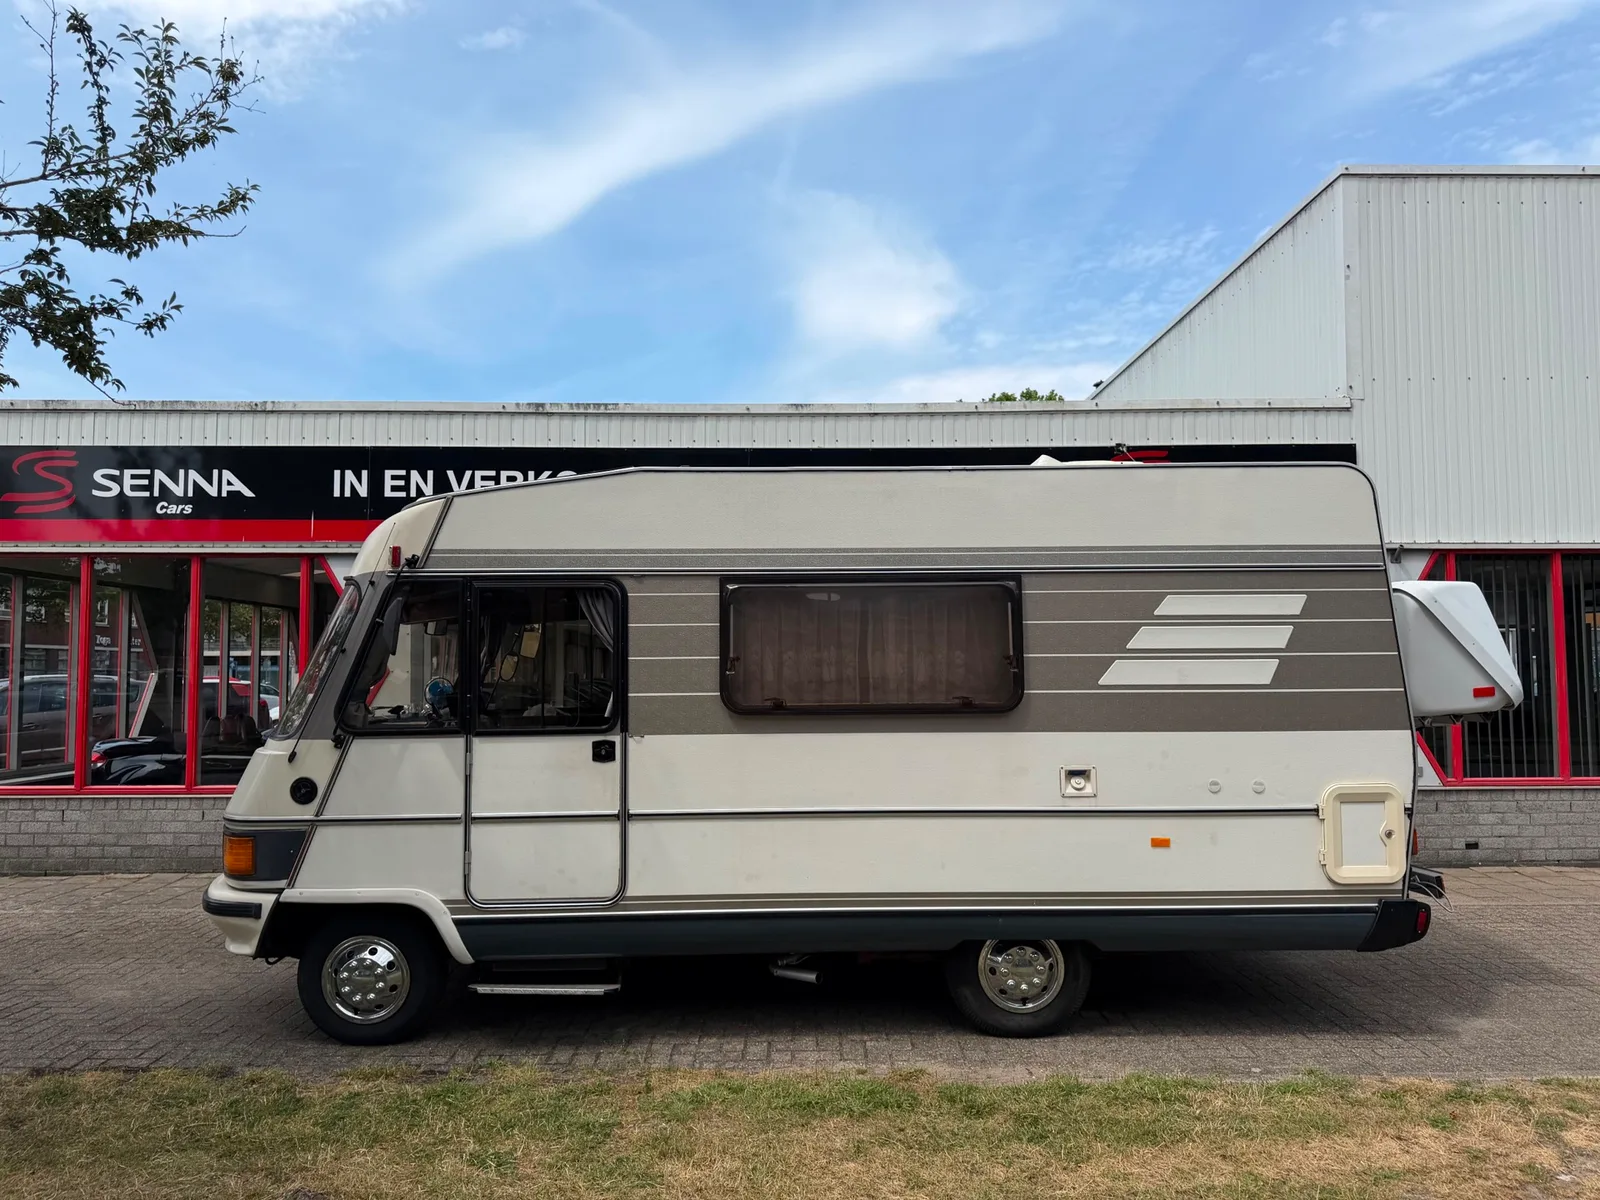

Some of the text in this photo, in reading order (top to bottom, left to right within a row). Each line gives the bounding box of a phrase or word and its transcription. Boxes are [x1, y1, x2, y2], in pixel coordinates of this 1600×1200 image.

[92, 468, 256, 497] SENNA
[333, 469, 577, 497] IN EN VER
[155, 501, 193, 514] Cars
